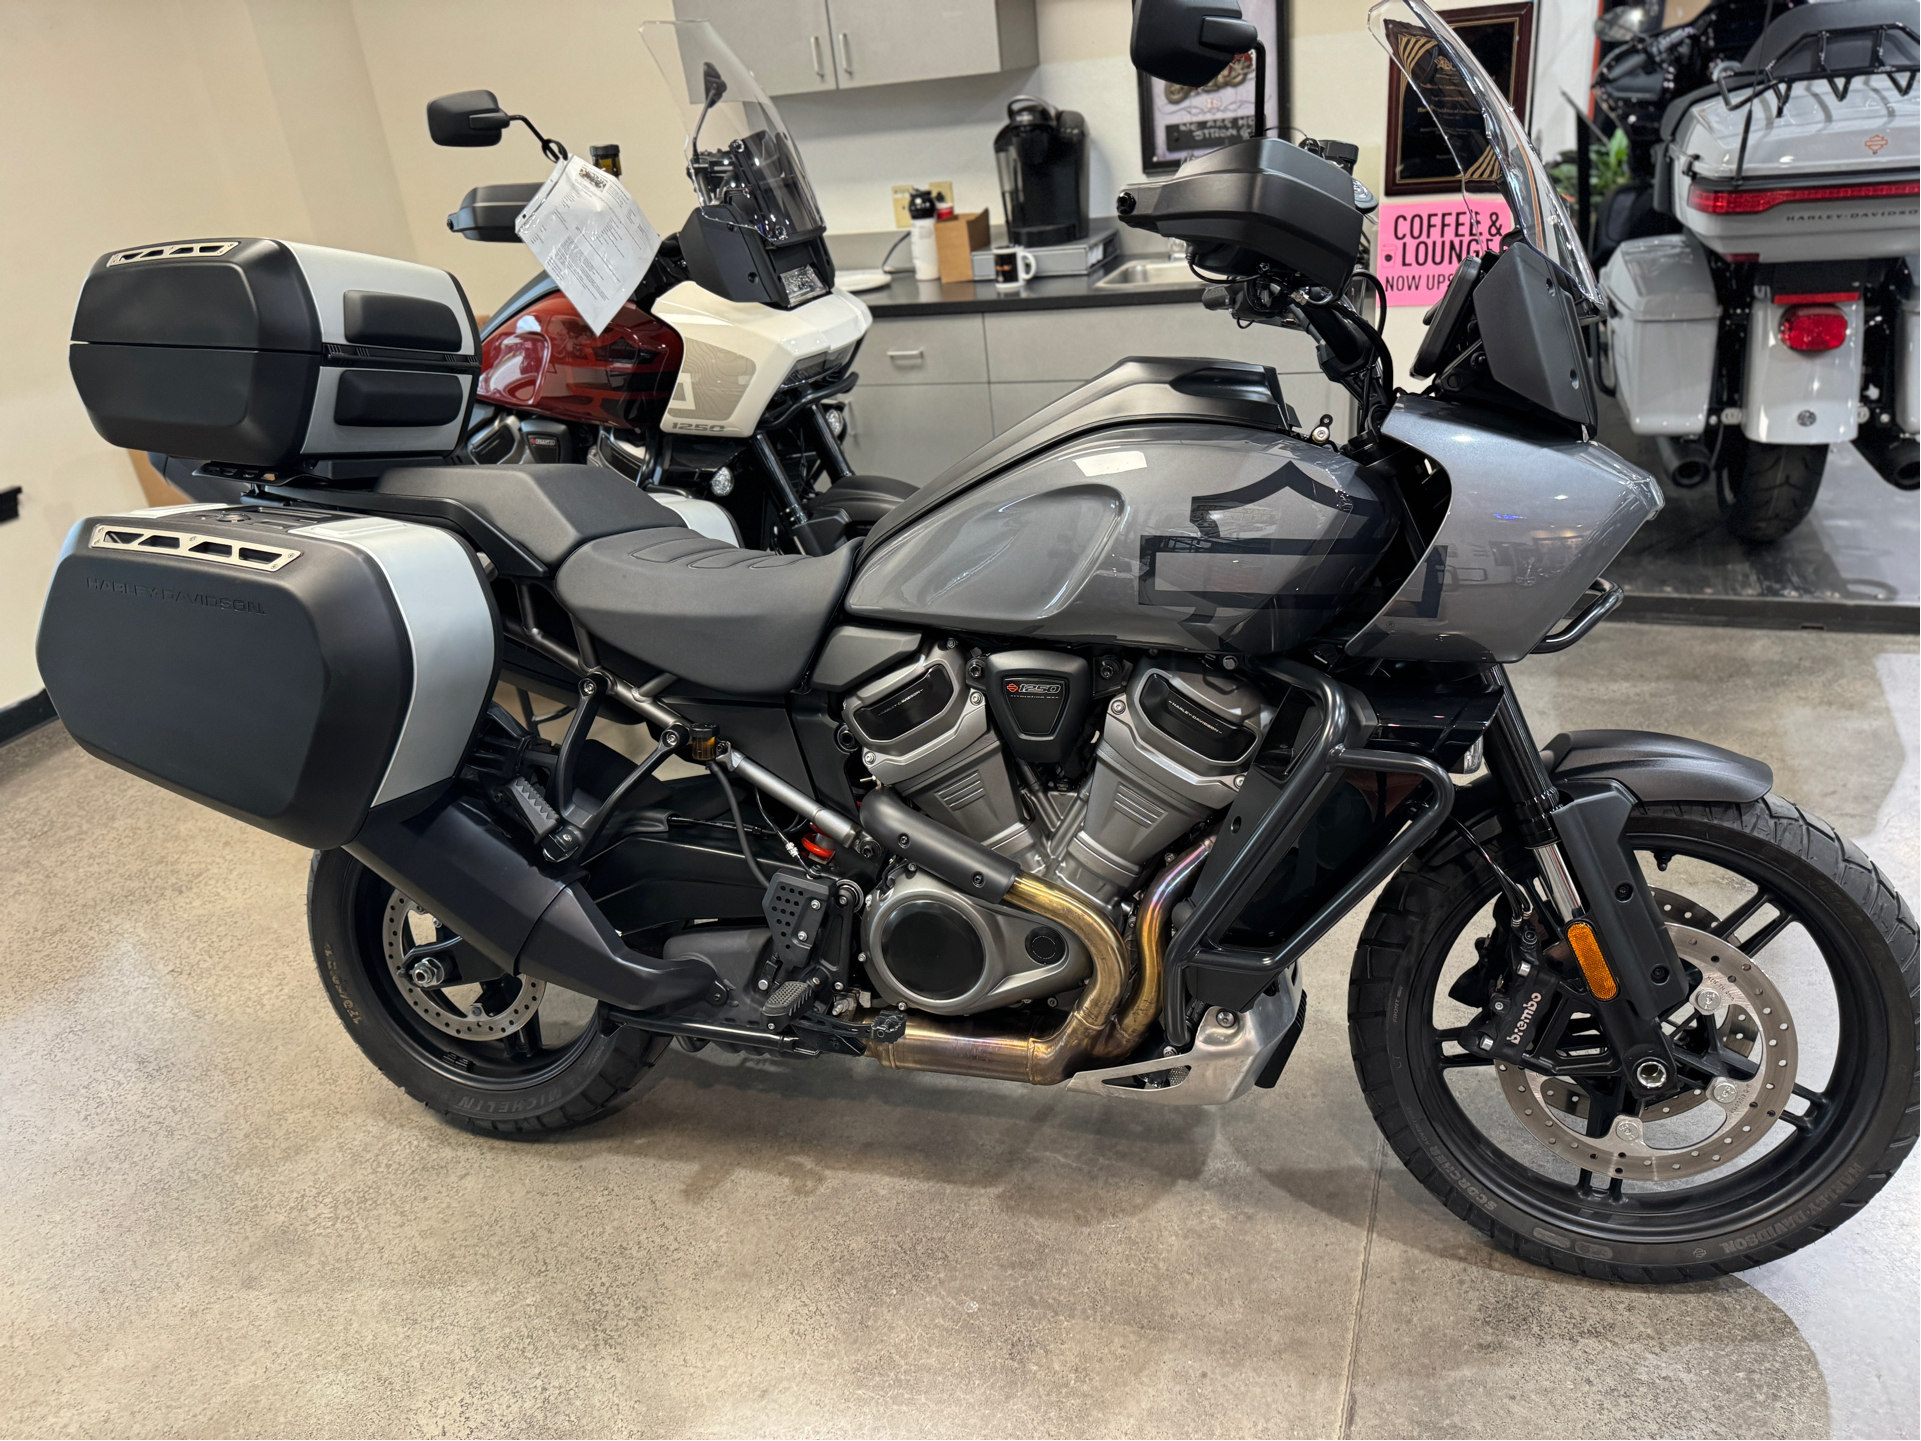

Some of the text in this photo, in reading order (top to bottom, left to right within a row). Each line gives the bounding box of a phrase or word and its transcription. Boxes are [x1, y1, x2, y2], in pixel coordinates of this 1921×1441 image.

[1394, 209, 1503, 240] COFFEE &
[1385, 275, 1422, 292] NOW
[672, 422, 726, 432] 1250
[1019, 683, 1061, 694] 1250
[1392, 999, 1400, 1023] FRONT
[1506, 992, 1542, 1045] brembo
[458, 1087, 561, 1113] MICHELIN
[1430, 1145, 1498, 1211] SCORCHER
[1720, 1161, 1865, 1255] HARLEY-DAVIDSON
